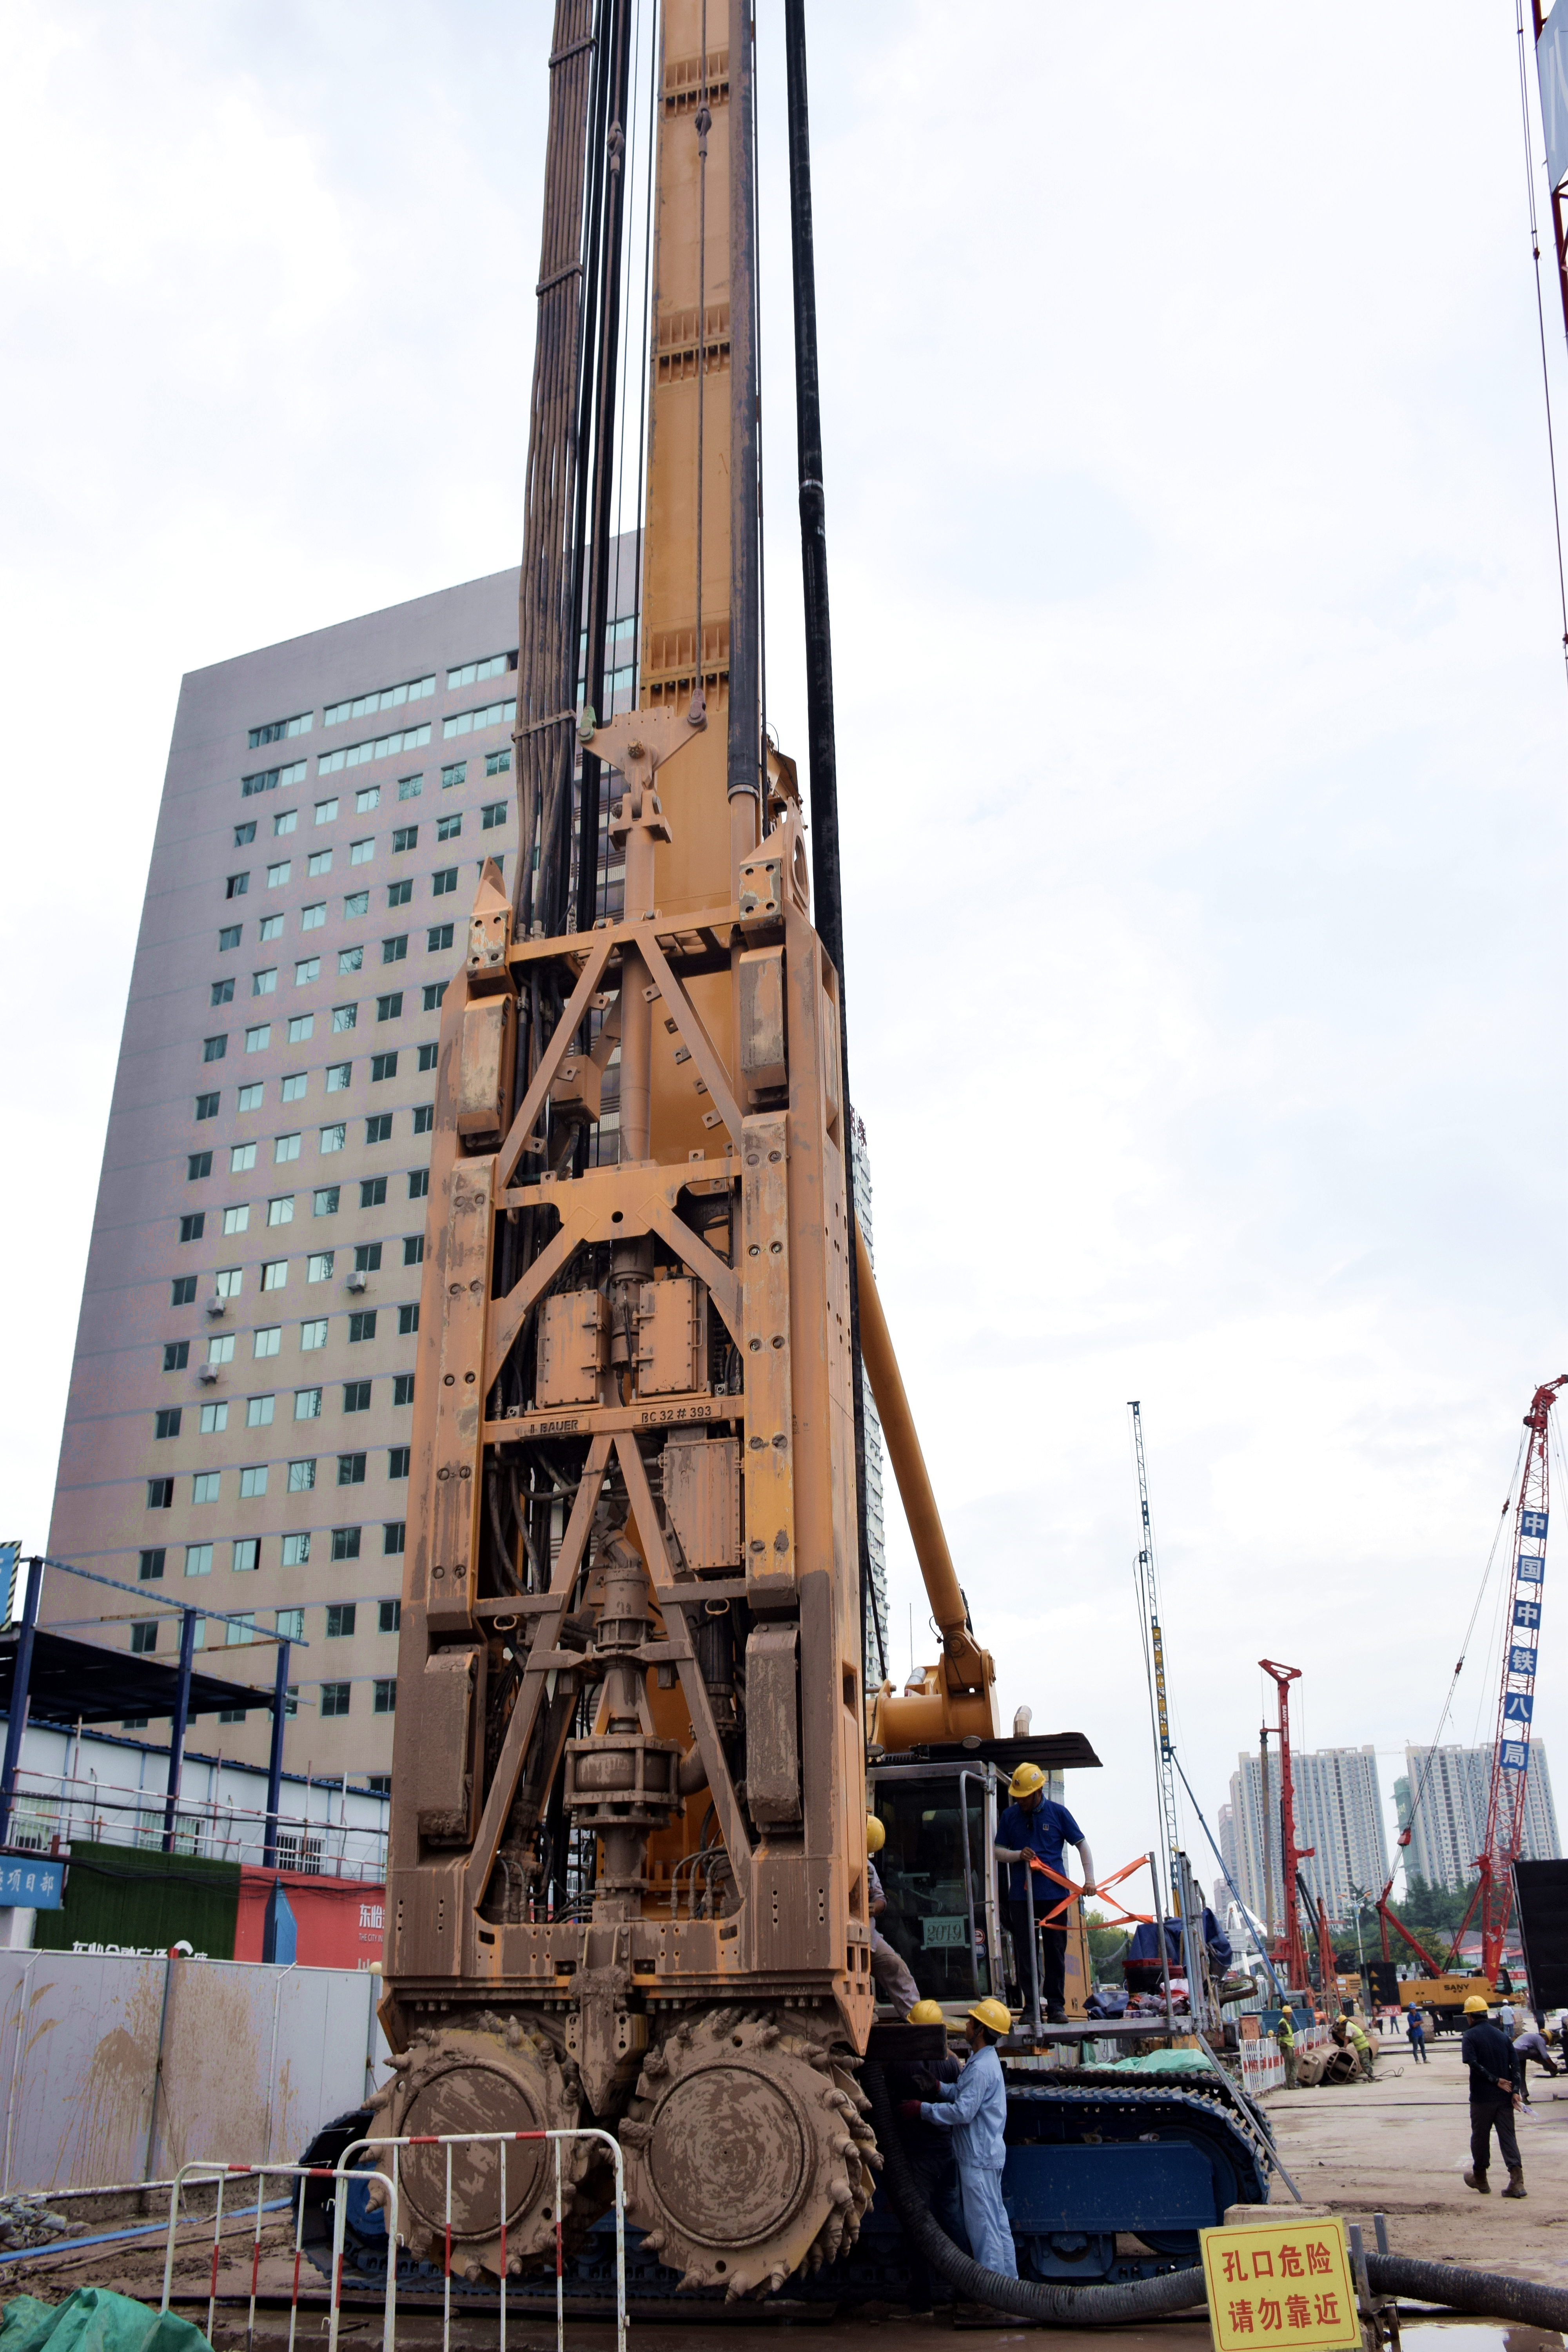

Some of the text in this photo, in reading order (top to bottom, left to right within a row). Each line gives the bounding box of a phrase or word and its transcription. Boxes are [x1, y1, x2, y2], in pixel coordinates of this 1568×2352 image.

[642, 1406, 711, 1423] BC 32 # 393
[540, 1419, 579, 1434] BAUER
[1503, 1514, 1545, 1767] 中国中铁八局
[359, 1904, 385, 1929] 东怡
[359, 1933, 367, 1942] THE
[368, 1933, 377, 1942] CITY
[927, 1924, 962, 1942] 2019
[1221, 2241, 1333, 2283] 孔口危险
[1228, 2292, 1341, 2333] 请勿靠近
